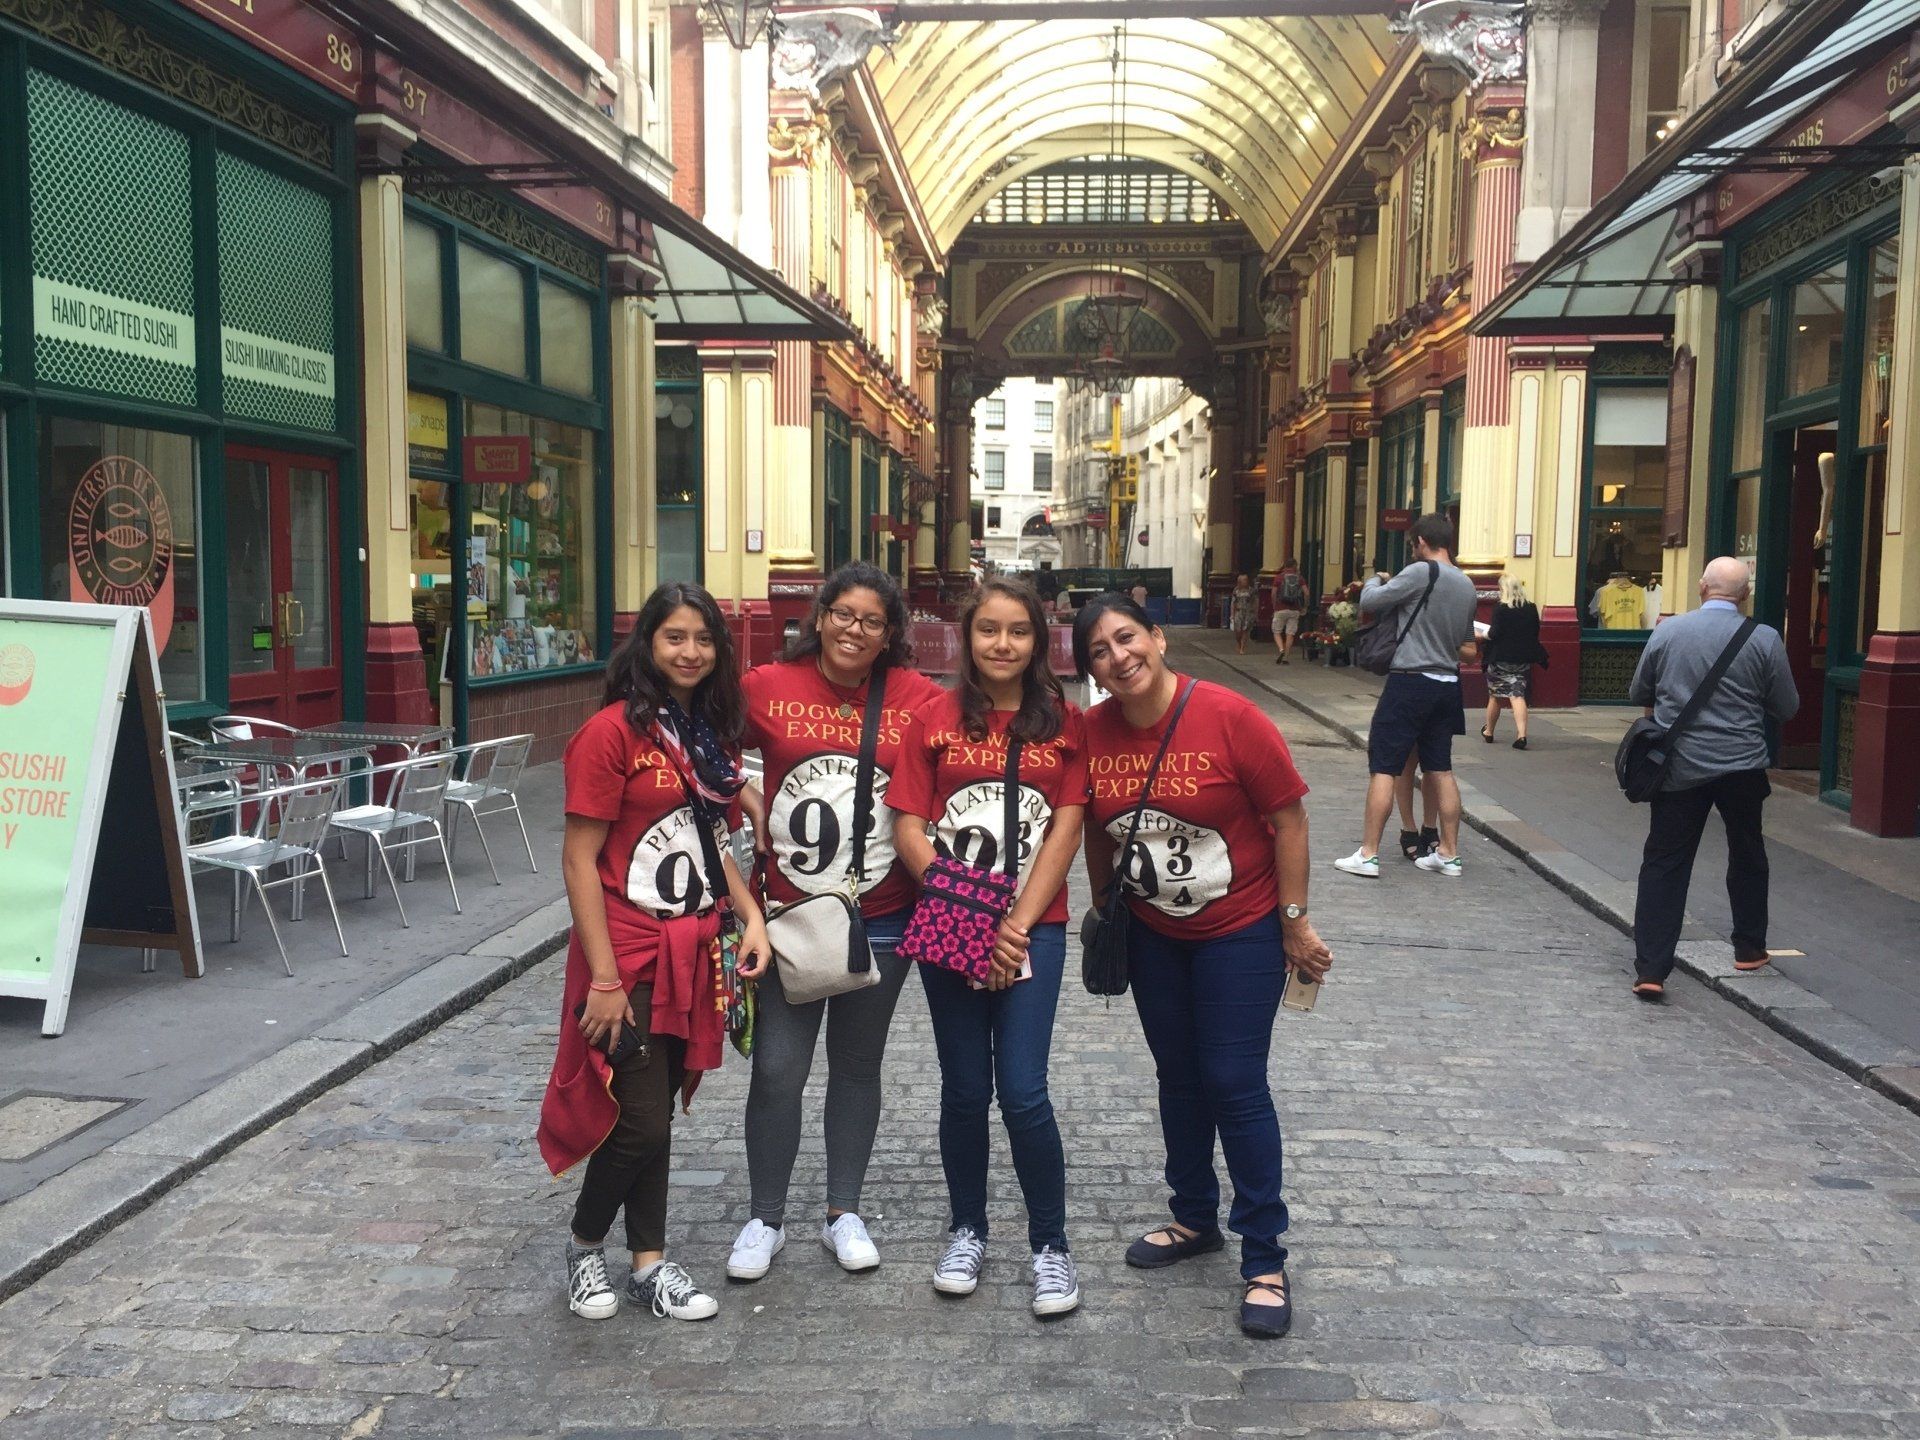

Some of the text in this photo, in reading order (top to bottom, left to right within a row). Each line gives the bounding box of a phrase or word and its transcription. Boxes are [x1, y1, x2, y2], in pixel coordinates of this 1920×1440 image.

[327, 33, 353, 72] 38
[1887, 57, 1909, 96] 65
[403, 81, 427, 117] 37
[596, 201, 611, 227] 37
[1097, 242, 1134, 254] 1881
[52, 295, 178, 350] HAND CRAFTED SUSHI
[225, 339, 327, 385] SUSHI MAKING CLASSES
[72, 461, 170, 568] UNIVERSITY OF SUSHI
[1739, 533, 1758, 552] SA
[92, 576, 156, 607] LONDON
[768, 699, 912, 727] HOGWATS
[0, 752, 66, 783] SUSHI
[634, 750, 667, 770] HO
[1088, 751, 1212, 776] HOGWRTS
[655, 769, 684, 789] EX
[0, 787, 71, 819] STORE
[789, 797, 840, 876] 9
[1166, 835, 1193, 877] 3
